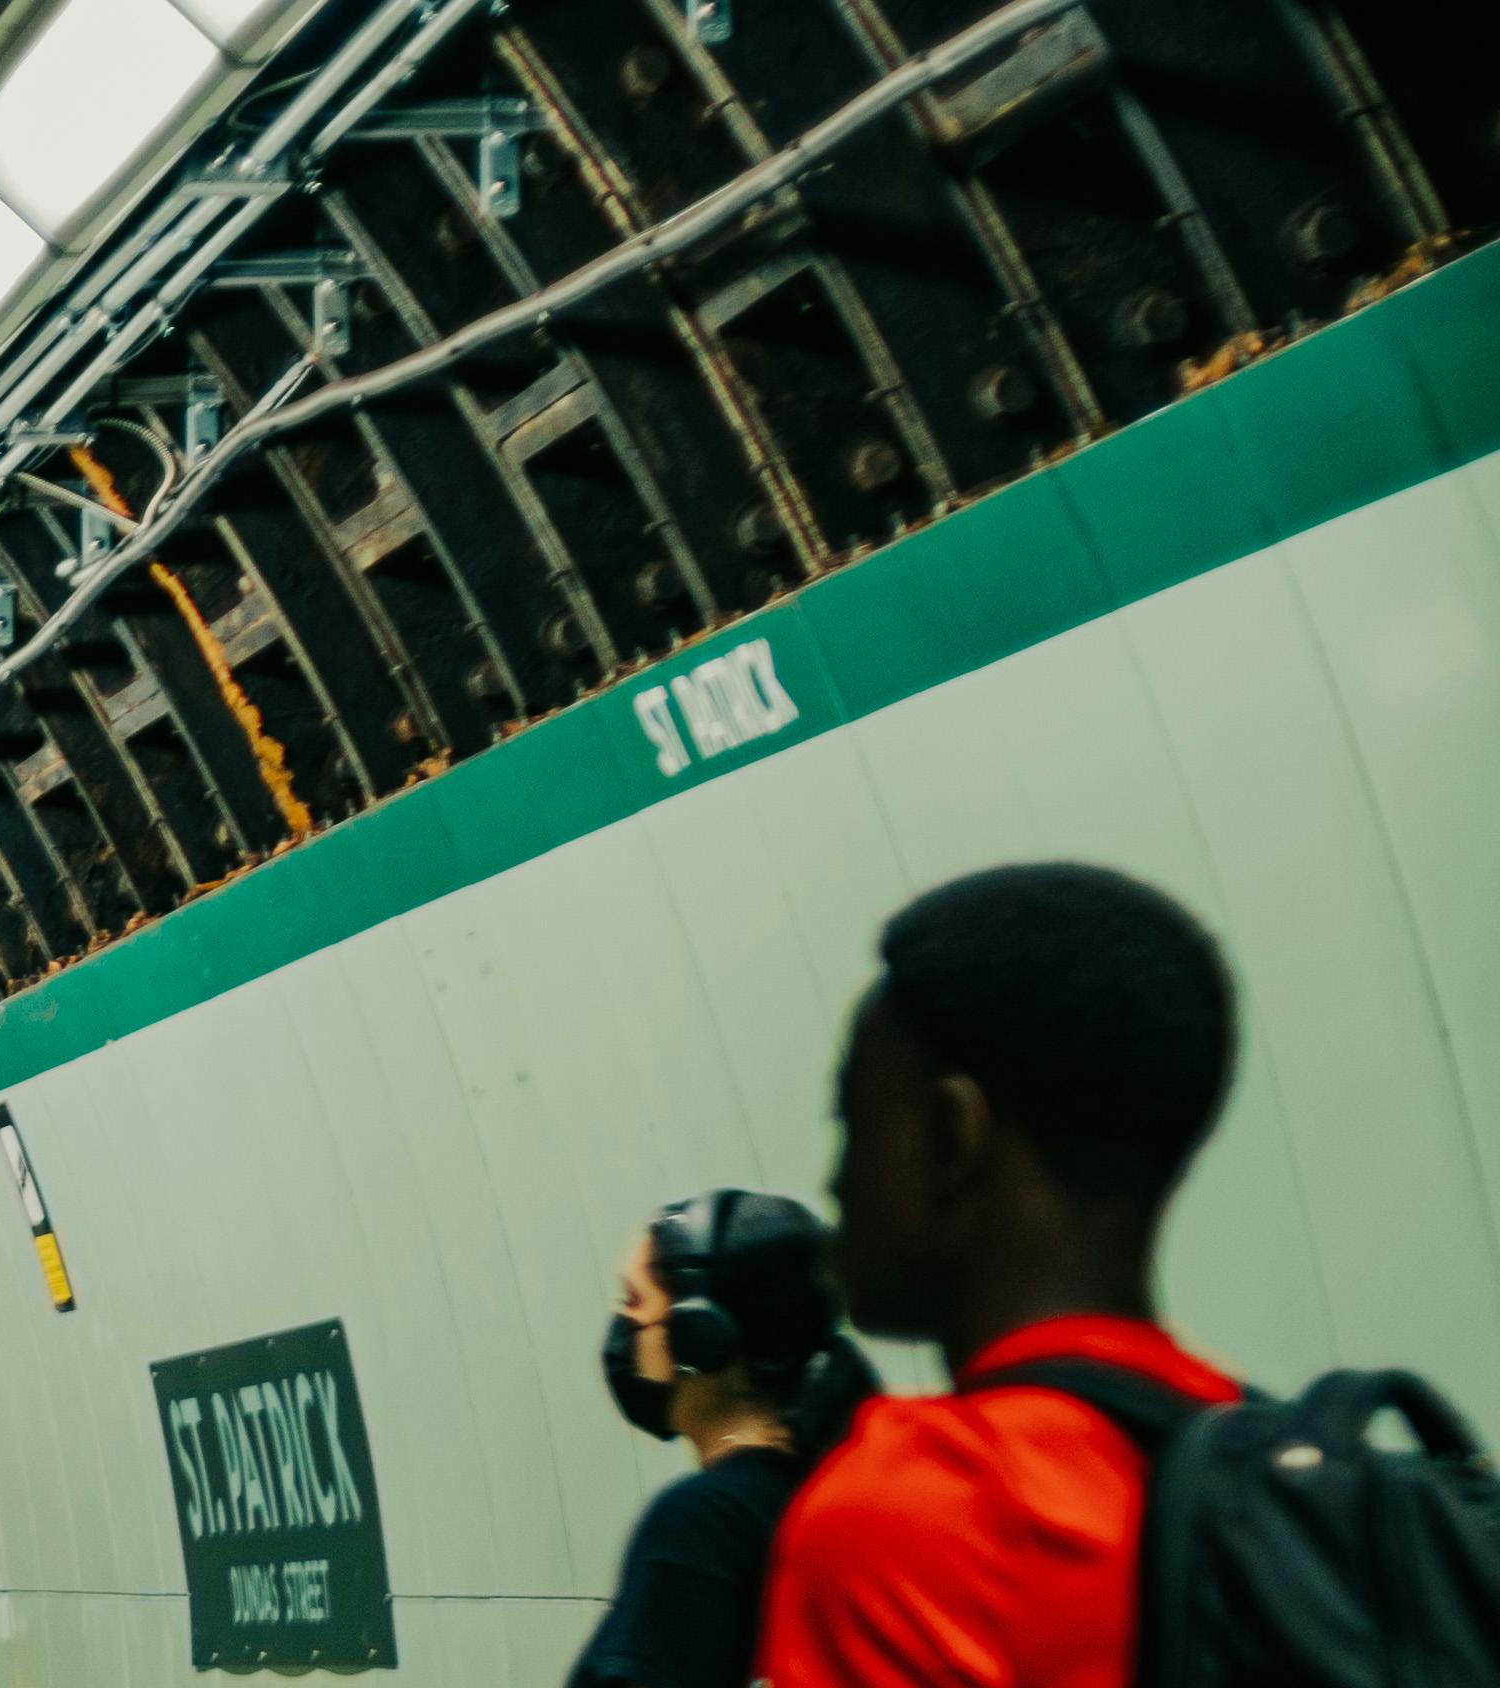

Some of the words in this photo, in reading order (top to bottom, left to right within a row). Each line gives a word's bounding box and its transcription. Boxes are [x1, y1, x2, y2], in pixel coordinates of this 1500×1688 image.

[168, 1396, 226, 1540] ST.
[211, 1368, 363, 1535] PATRICK
[229, 1560, 280, 1626] DUNDAS
[282, 1558, 331, 1624] STREET
